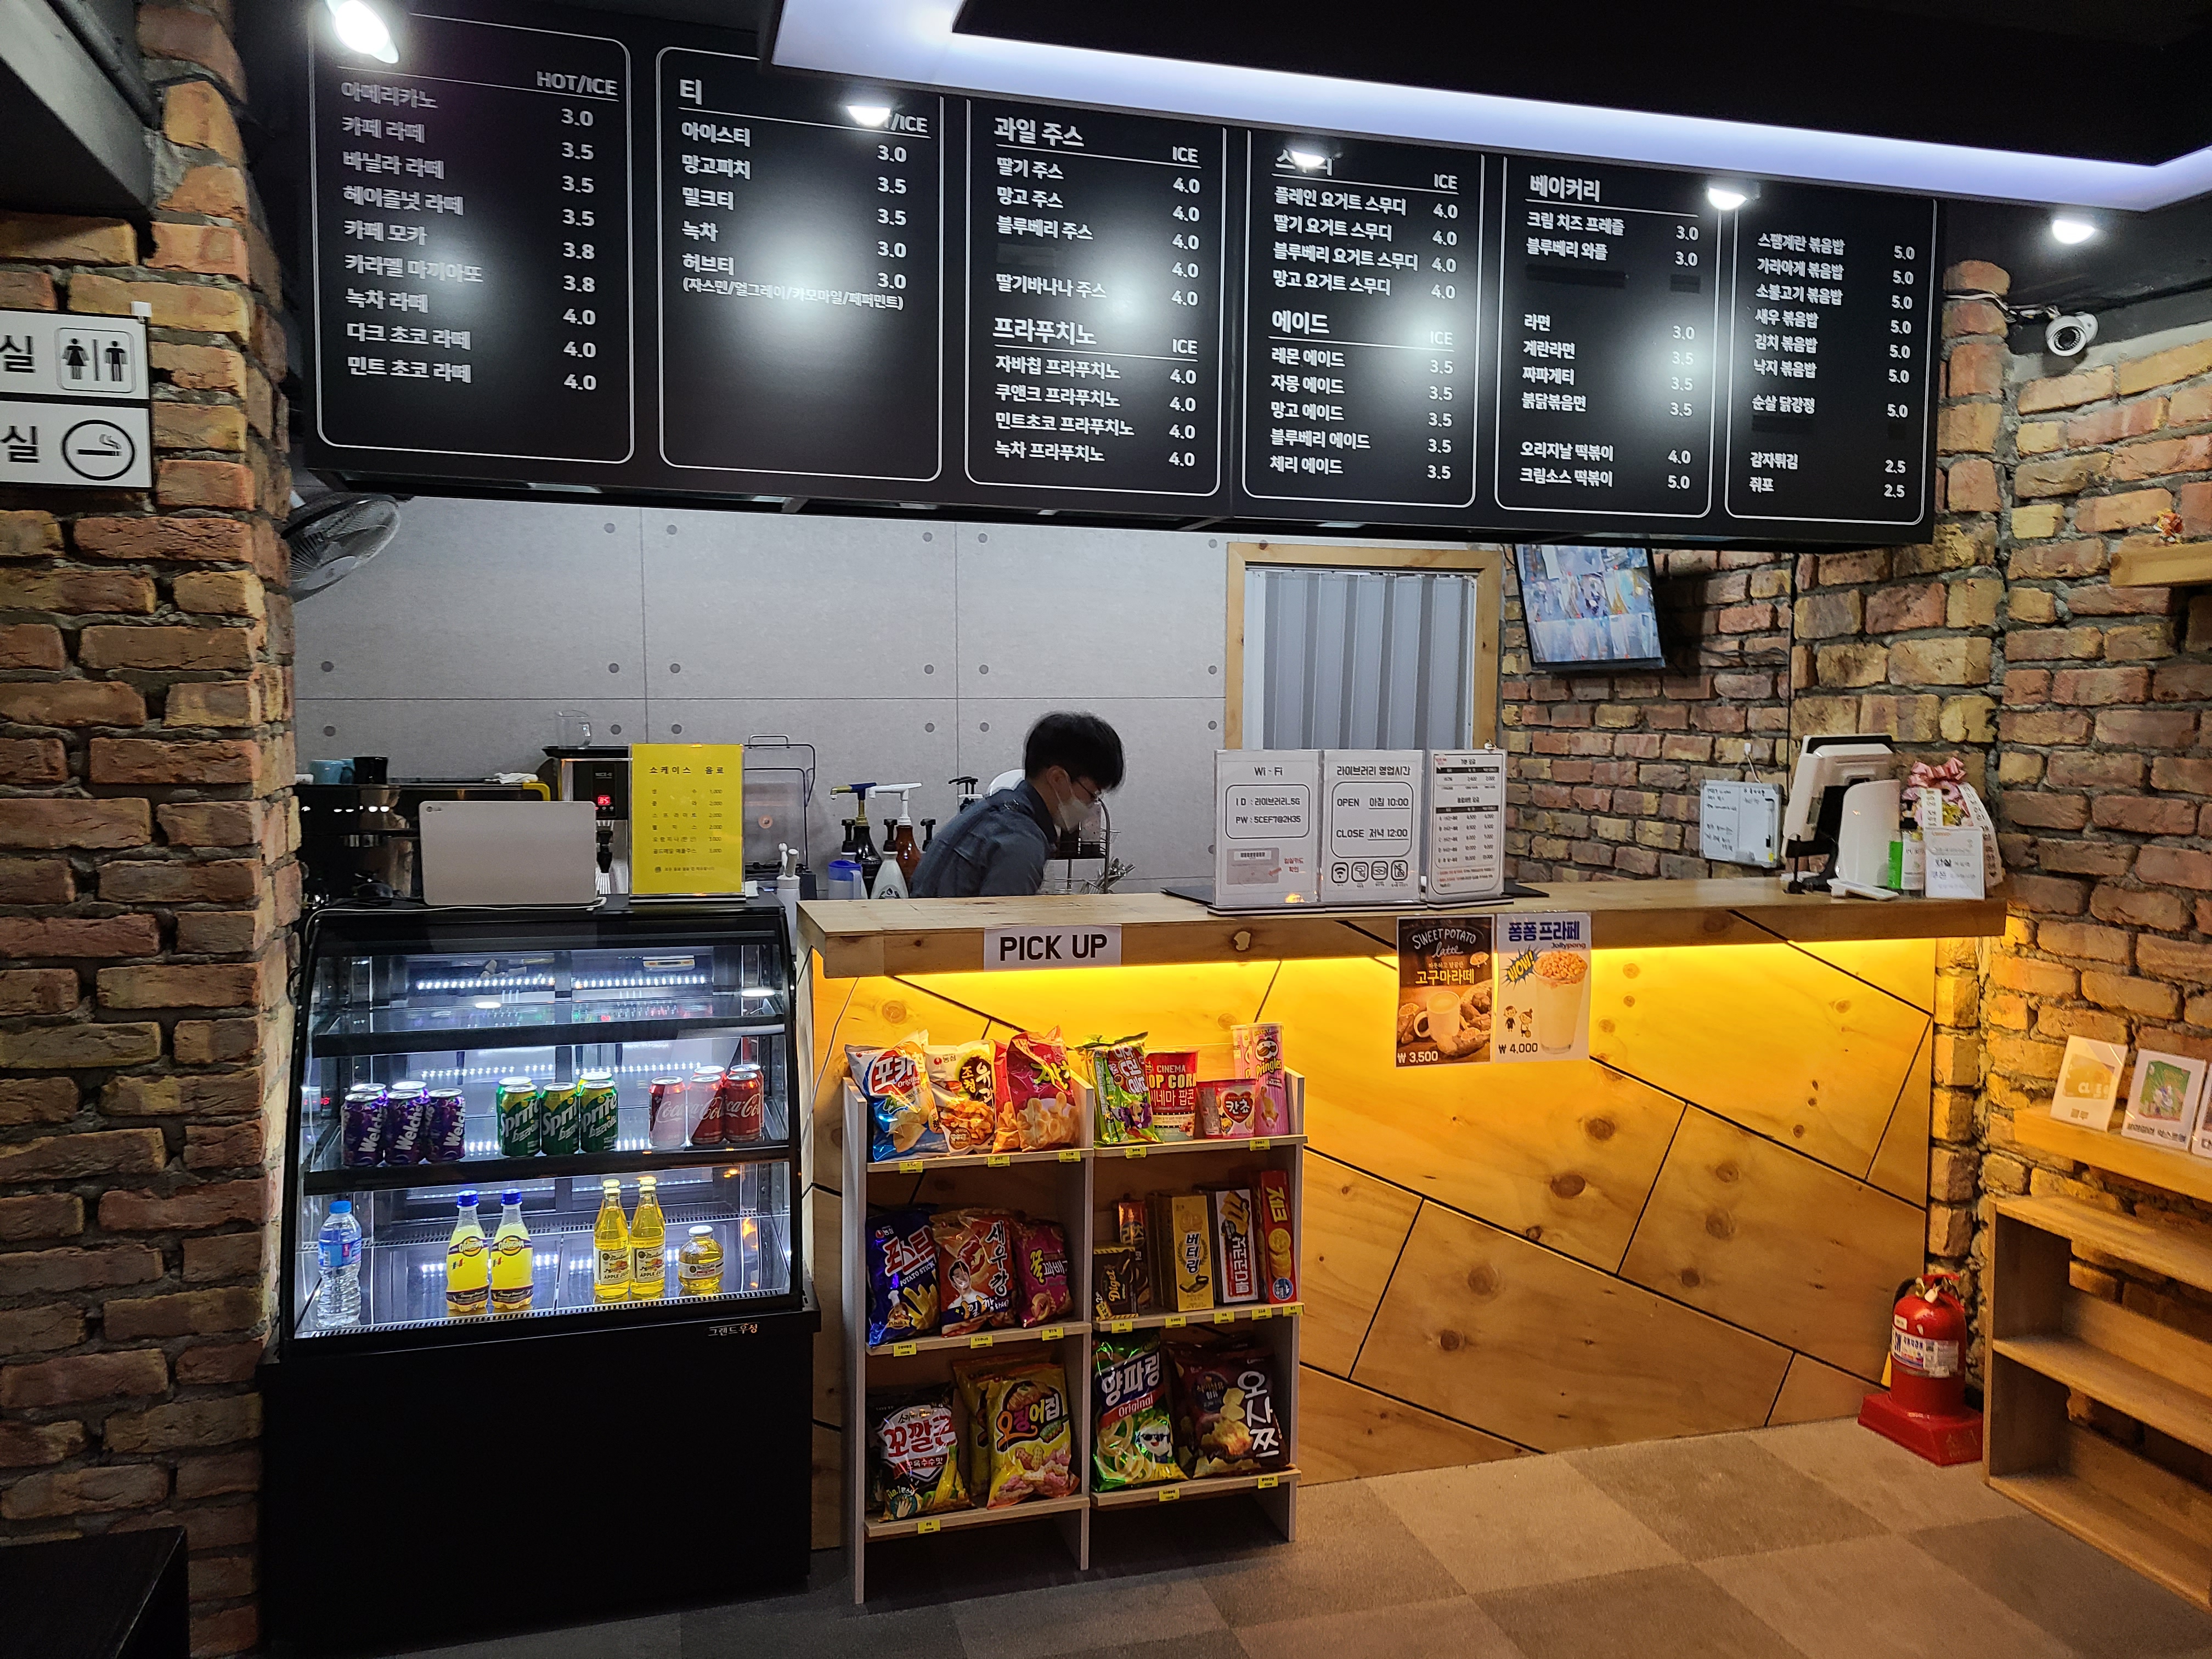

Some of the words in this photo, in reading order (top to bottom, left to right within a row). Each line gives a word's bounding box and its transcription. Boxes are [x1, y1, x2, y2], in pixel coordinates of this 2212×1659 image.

[537, 71, 619, 96] HOT/ICE
[680, 80, 702, 105] 티
[341, 82, 438, 108] 아메리카노
[561, 109, 593, 126] 3.0
[342, 117, 381, 138] 카페
[386, 122, 425, 143] 라떼
[562, 142, 594, 160] 3.5
[682, 122, 750, 147] 아이스티
[878, 145, 906, 162] 3.0
[994, 117, 1036, 144] 과일
[1042, 123, 1084, 146] 주스
[1173, 146, 1198, 163] ICE
[682, 155, 750, 179] 망고피치
[878, 177, 906, 194] 3.5
[997, 157, 1028, 177] 딸기
[1032, 161, 1064, 179] 주스
[1173, 178, 1199, 193] 4.0
[1435, 174, 1457, 189] ICE
[1531, 175, 1600, 202] 베이커리
[343, 185, 420, 211] 헤이즐넛
[425, 194, 463, 215] 라떼
[563, 209, 594, 226] 3.5
[682, 187, 733, 210] 밀크티
[878, 208, 906, 225] 3.5
[1274, 186, 1317, 207] 플레인
[1320, 192, 1362, 210] 요거트
[1364, 196, 1406, 216] 스무디
[1434, 204, 1458, 218] 4.0
[996, 215, 1058, 238] 블루베리
[1062, 222, 1093, 240] 주스
[1172, 234, 1199, 249] 4.0
[1527, 212, 1553, 229] 크림
[1557, 213, 1583, 231] 치즈
[1585, 217, 1625, 236] 프레즐
[1676, 225, 1699, 240] 3.0
[1273, 242, 1329, 263] 블루베리
[1333, 248, 1374, 266] 요거트
[1377, 252, 1418, 271] 스무디
[1432, 257, 1456, 272] 4.0
[1526, 237, 1578, 258] 블루베리
[1581, 242, 1608, 261] 와플
[1675, 251, 1697, 266] 3.0
[1758, 233, 1807, 252] 스팸계란
[1808, 236, 1845, 255] 볶음밥
[1894, 246, 1915, 259] 5.0
[345, 255, 403, 277] 카라멜
[408, 260, 483, 282] 마끼아또
[563, 275, 595, 292] 3.8
[682, 253, 733, 275] 허브티
[878, 273, 906, 289] 3.0
[1756, 284, 1804, 302] 소불고기
[1807, 287, 1843, 305] 볶음밥
[1892, 295, 1912, 309] 5.0
[347, 323, 386, 341] 다크
[390, 326, 429, 344] 초코
[433, 329, 471, 350] 라떼
[563, 342, 596, 357] 4.0
[992, 318, 1096, 345] 프라푸치노
[1173, 339, 1197, 354] ICE
[1272, 311, 1329, 335] 에이드
[1431, 331, 1453, 345] ICE
[1525, 314, 1550, 331] 라면
[1673, 326, 1694, 340] 3.0
[0, 335, 36, 373] 실
[996, 355, 1041, 375] 자바칩
[1045, 359, 1120, 379] 프라푸치노
[1170, 369, 1196, 383] 4.0
[1522, 366, 1574, 385] 짜파게티
[1671, 377, 1692, 391] 3.5
[1754, 359, 1778, 376] 낙지
[1780, 360, 1817, 378] 볶음밥
[1889, 369, 1909, 383] 5.0
[1271, 374, 1300, 392] 자몽
[1303, 377, 1345, 394] 에이드
[1429, 386, 1452, 400] 3.5
[1752, 394, 1778, 411] 순살
[1780, 396, 1815, 414] 닭강정
[1887, 404, 1908, 417] 5.0
[996, 412, 1057, 430] 민트초코
[1059, 417, 1135, 436] 프라푸치노
[1169, 425, 1195, 439] 4.0
[1, 425, 40, 463] 실
[1520, 442, 1573, 460] 오리지날
[1575, 444, 1613, 461] 떡볶이
[1668, 450, 1690, 464] 4.0
[1270, 455, 1297, 473] 체리
[1301, 458, 1343, 475] 에이드
[1427, 465, 1451, 479] 3.5
[1750, 477, 1774, 493] 쥐포
[1884, 484, 1904, 498] 2.5
[1336, 766, 1376, 776] 라이브러리
[1379, 765, 1410, 776] 영업시간
[1337, 798, 1359, 807] OPEN
[1369, 798, 1384, 807] 아침
[1387, 797, 1409, 806] 10:00
[1336, 829, 1364, 838] CLOSE
[1369, 828, 1384, 838] 저녁
[1387, 828, 1408, 837] 12:00
[1412, 928, 1444, 950] SWEET
[1444, 928, 1476, 944] POTATO
[1539, 921, 1580, 941] 프라페
[1000, 935, 1062, 961] PICK
[1073, 934, 1107, 958] UP
[1415, 968, 1475, 985] 고구마라떼
[1507, 951, 1536, 982] WOW!
[1156, 1065, 1186, 1073] CINEMA
[1255, 1059, 1282, 1081] Pringles
[1178, 1089, 1195, 1107] 팝콘
[1225, 1098, 1252, 1116] 칸쵸
[1266, 1186, 1288, 1223] 제크
[985, 1219, 1009, 1297] 새우깡
[1185, 1233, 1201, 1275] 버터링
[900, 1271, 919, 1287] POTATO
[1100, 1351, 1160, 1407] 양파링
[1118, 1394, 1153, 1418] Original
[1237, 1370, 1281, 1457] 오사쯔
[882, 1414, 958, 1458] 꼬깔콘
[996, 1392, 1061, 1453] 오징어집
